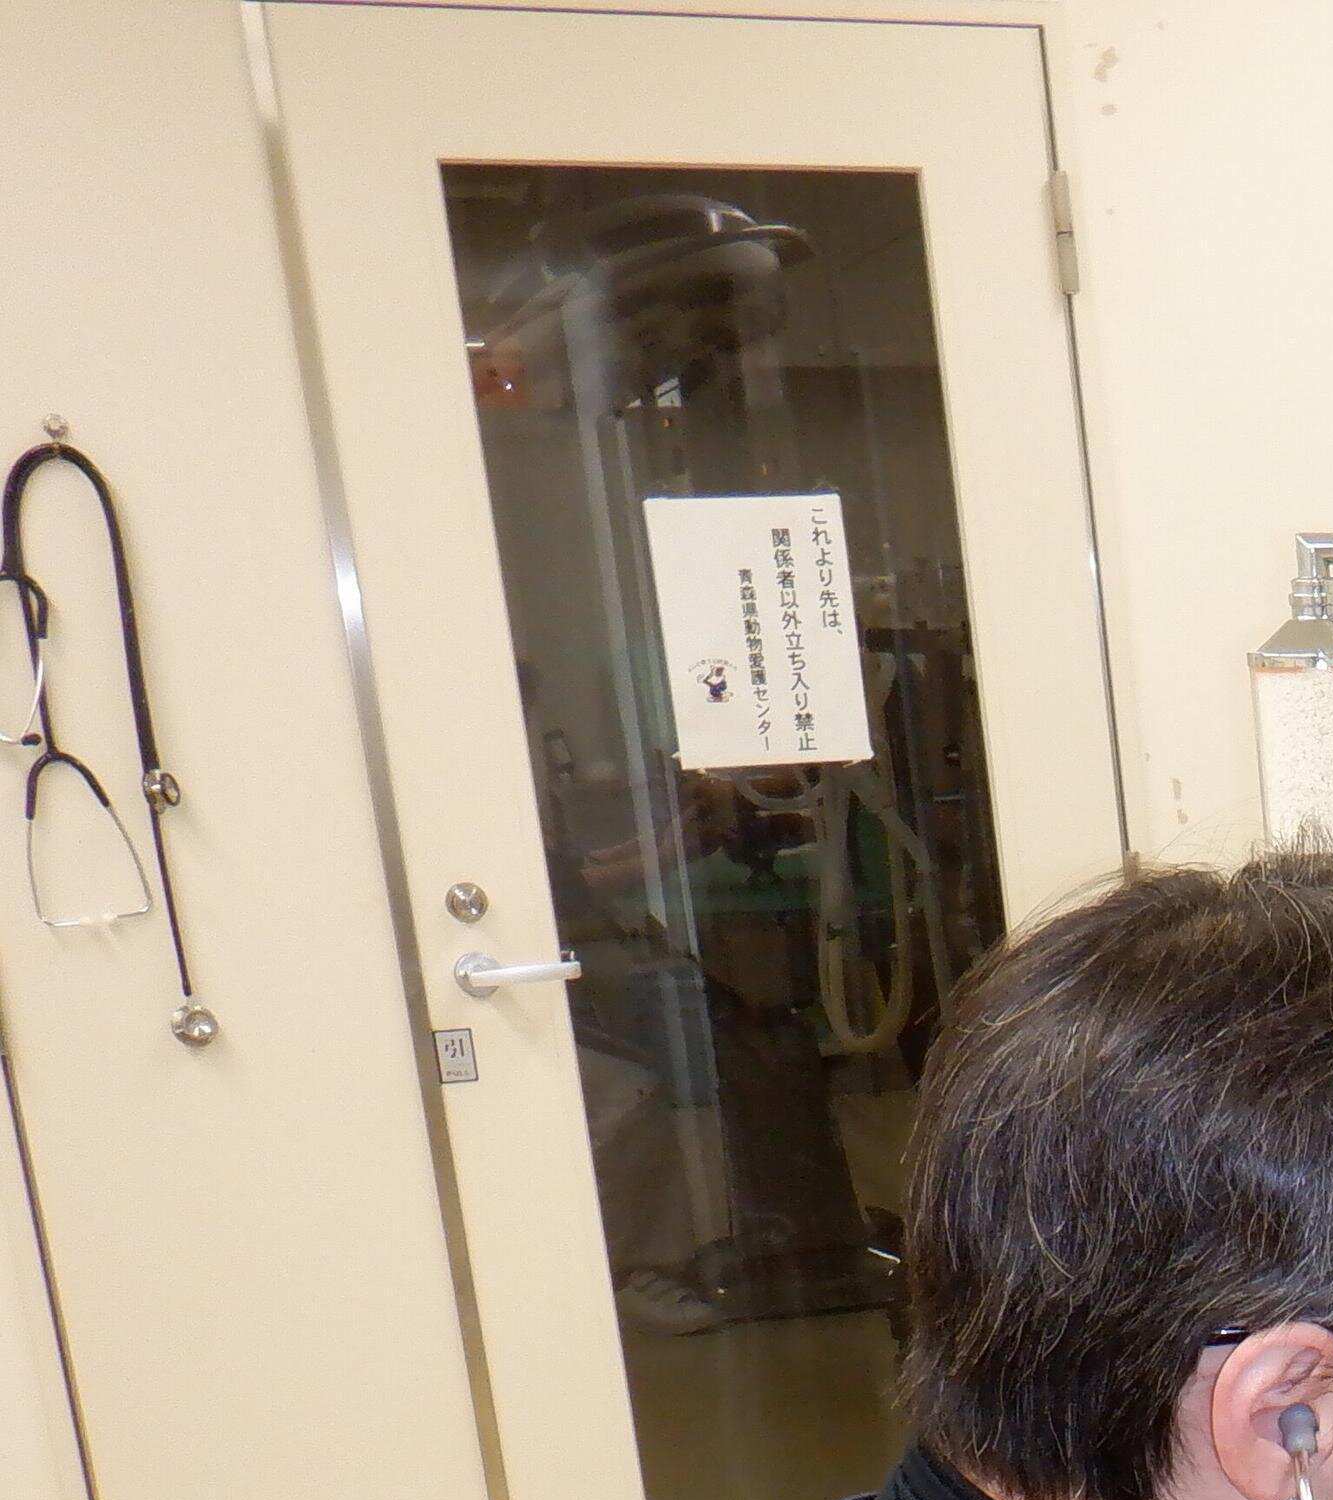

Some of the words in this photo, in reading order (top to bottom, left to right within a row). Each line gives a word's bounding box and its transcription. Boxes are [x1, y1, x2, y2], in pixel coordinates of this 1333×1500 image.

[737, 567, 771, 752] 青森県動物愛護センター
[771, 527, 818, 753] 関係者以外立ち入り禁止
[810, 507, 843, 636] これより先は、
